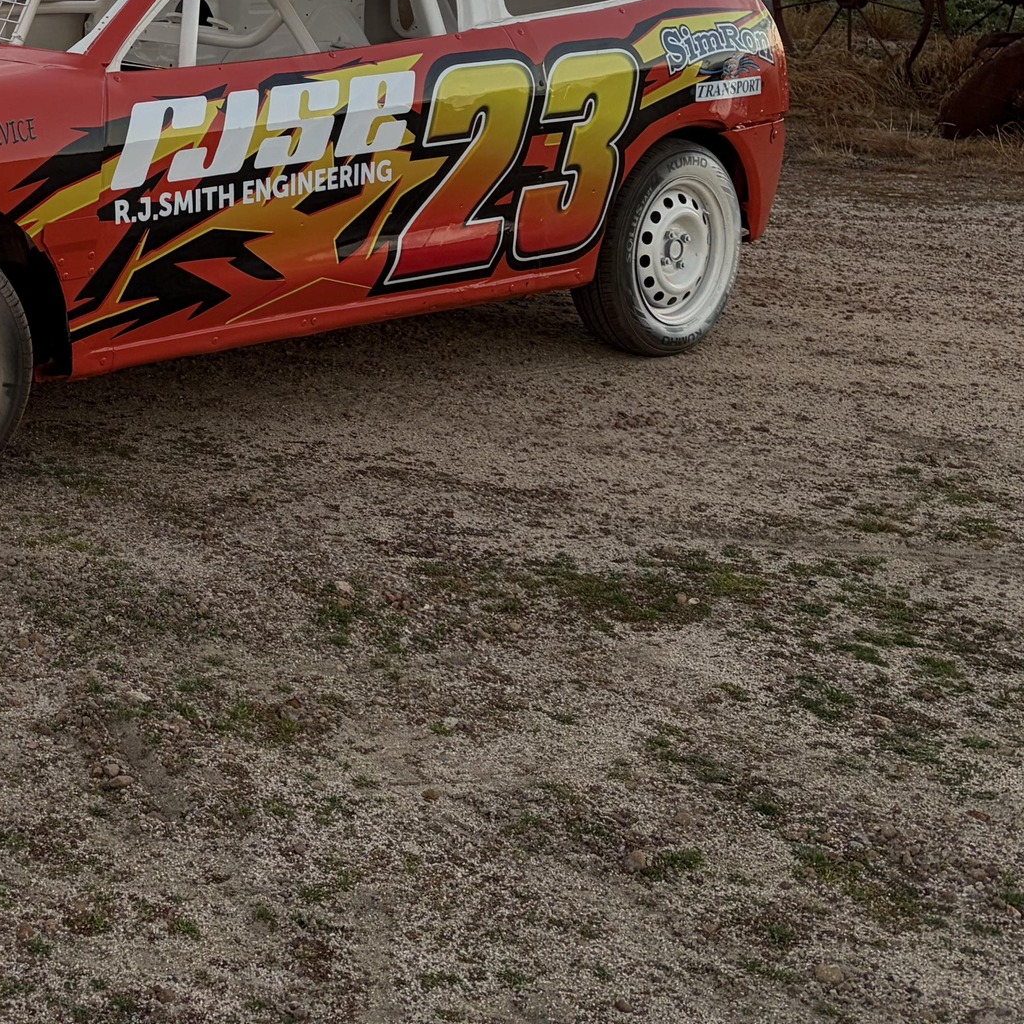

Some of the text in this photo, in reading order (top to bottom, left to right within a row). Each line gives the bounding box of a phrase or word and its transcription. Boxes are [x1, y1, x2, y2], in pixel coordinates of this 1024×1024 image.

[661, 22, 775, 75] SimRon
[698, 78, 761, 98] TRANSPORT
[242, 159, 393, 206] ENGINEERING
[383, 48, 640, 285] 23
[666, 156, 708, 173] KUMHO
[625, 203, 643, 263] SOLUS
[661, 329, 702, 346] KUMHO
